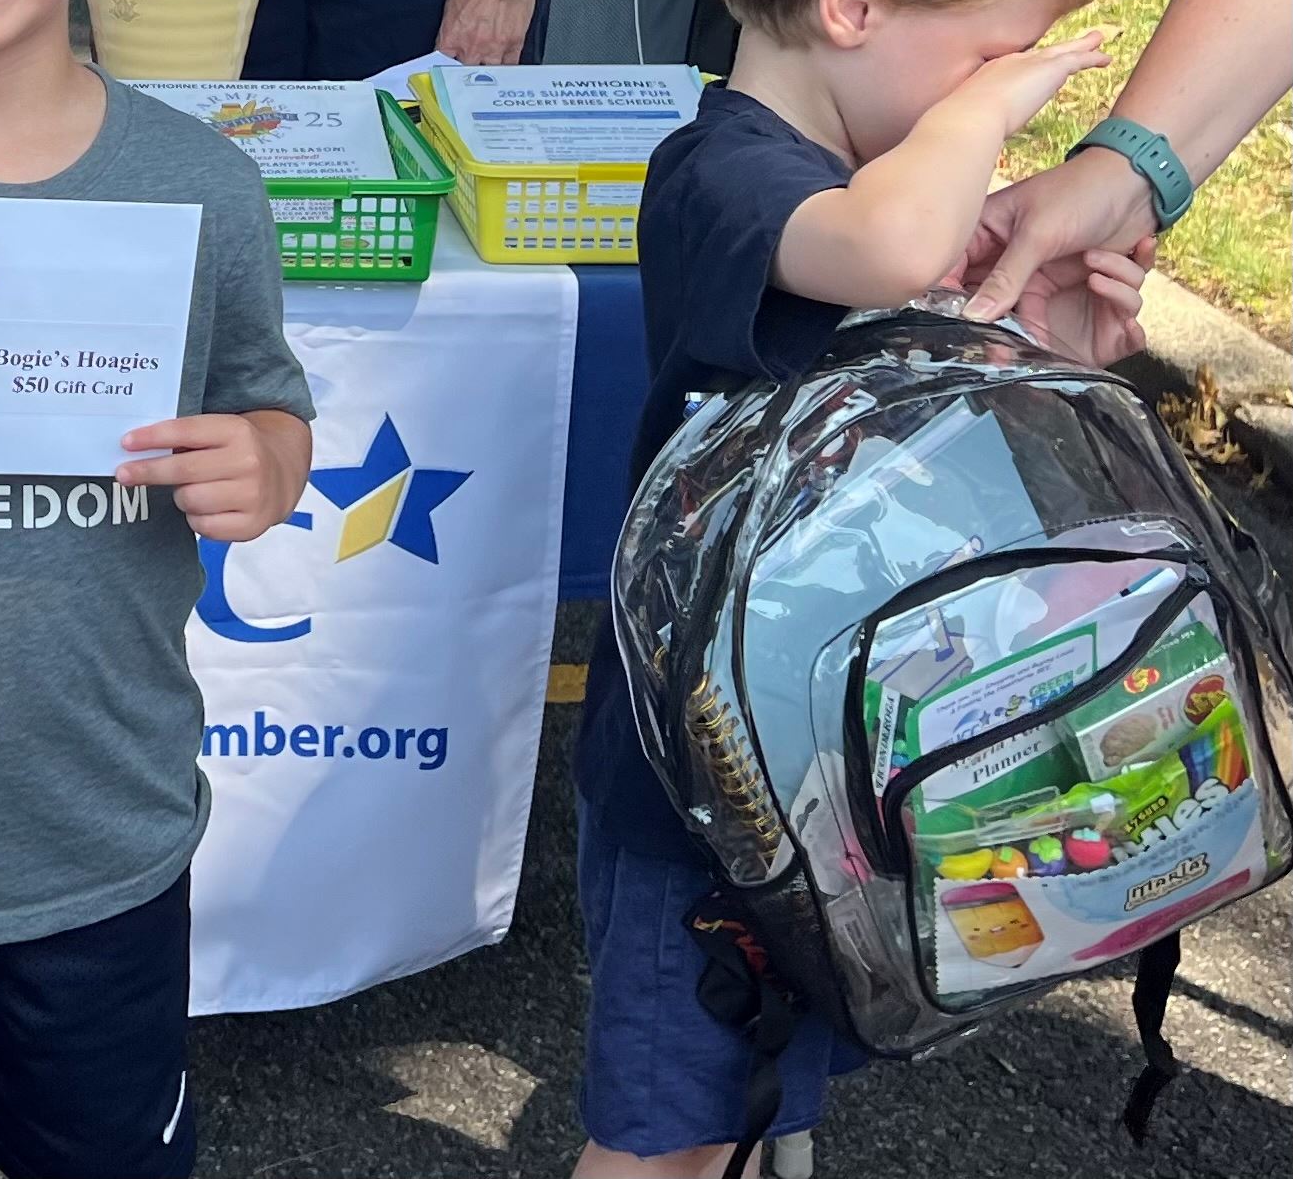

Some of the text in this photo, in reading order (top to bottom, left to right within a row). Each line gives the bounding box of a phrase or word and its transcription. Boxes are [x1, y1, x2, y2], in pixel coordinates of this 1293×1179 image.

[201, 83, 258, 91] CHAMBER
[540, 90, 608, 98] SUMMER
[613, 90, 635, 98] OF
[640, 90, 671, 98] FUN
[492, 98, 675, 107] CONCERT SERIES SCHEDULE
[76, 350, 159, 373] Hoagies
[12, 376, 134, 396] $50 Gift Card
[201, 711, 449, 770] mber.org
[972, 739, 1043, 784] Planner
